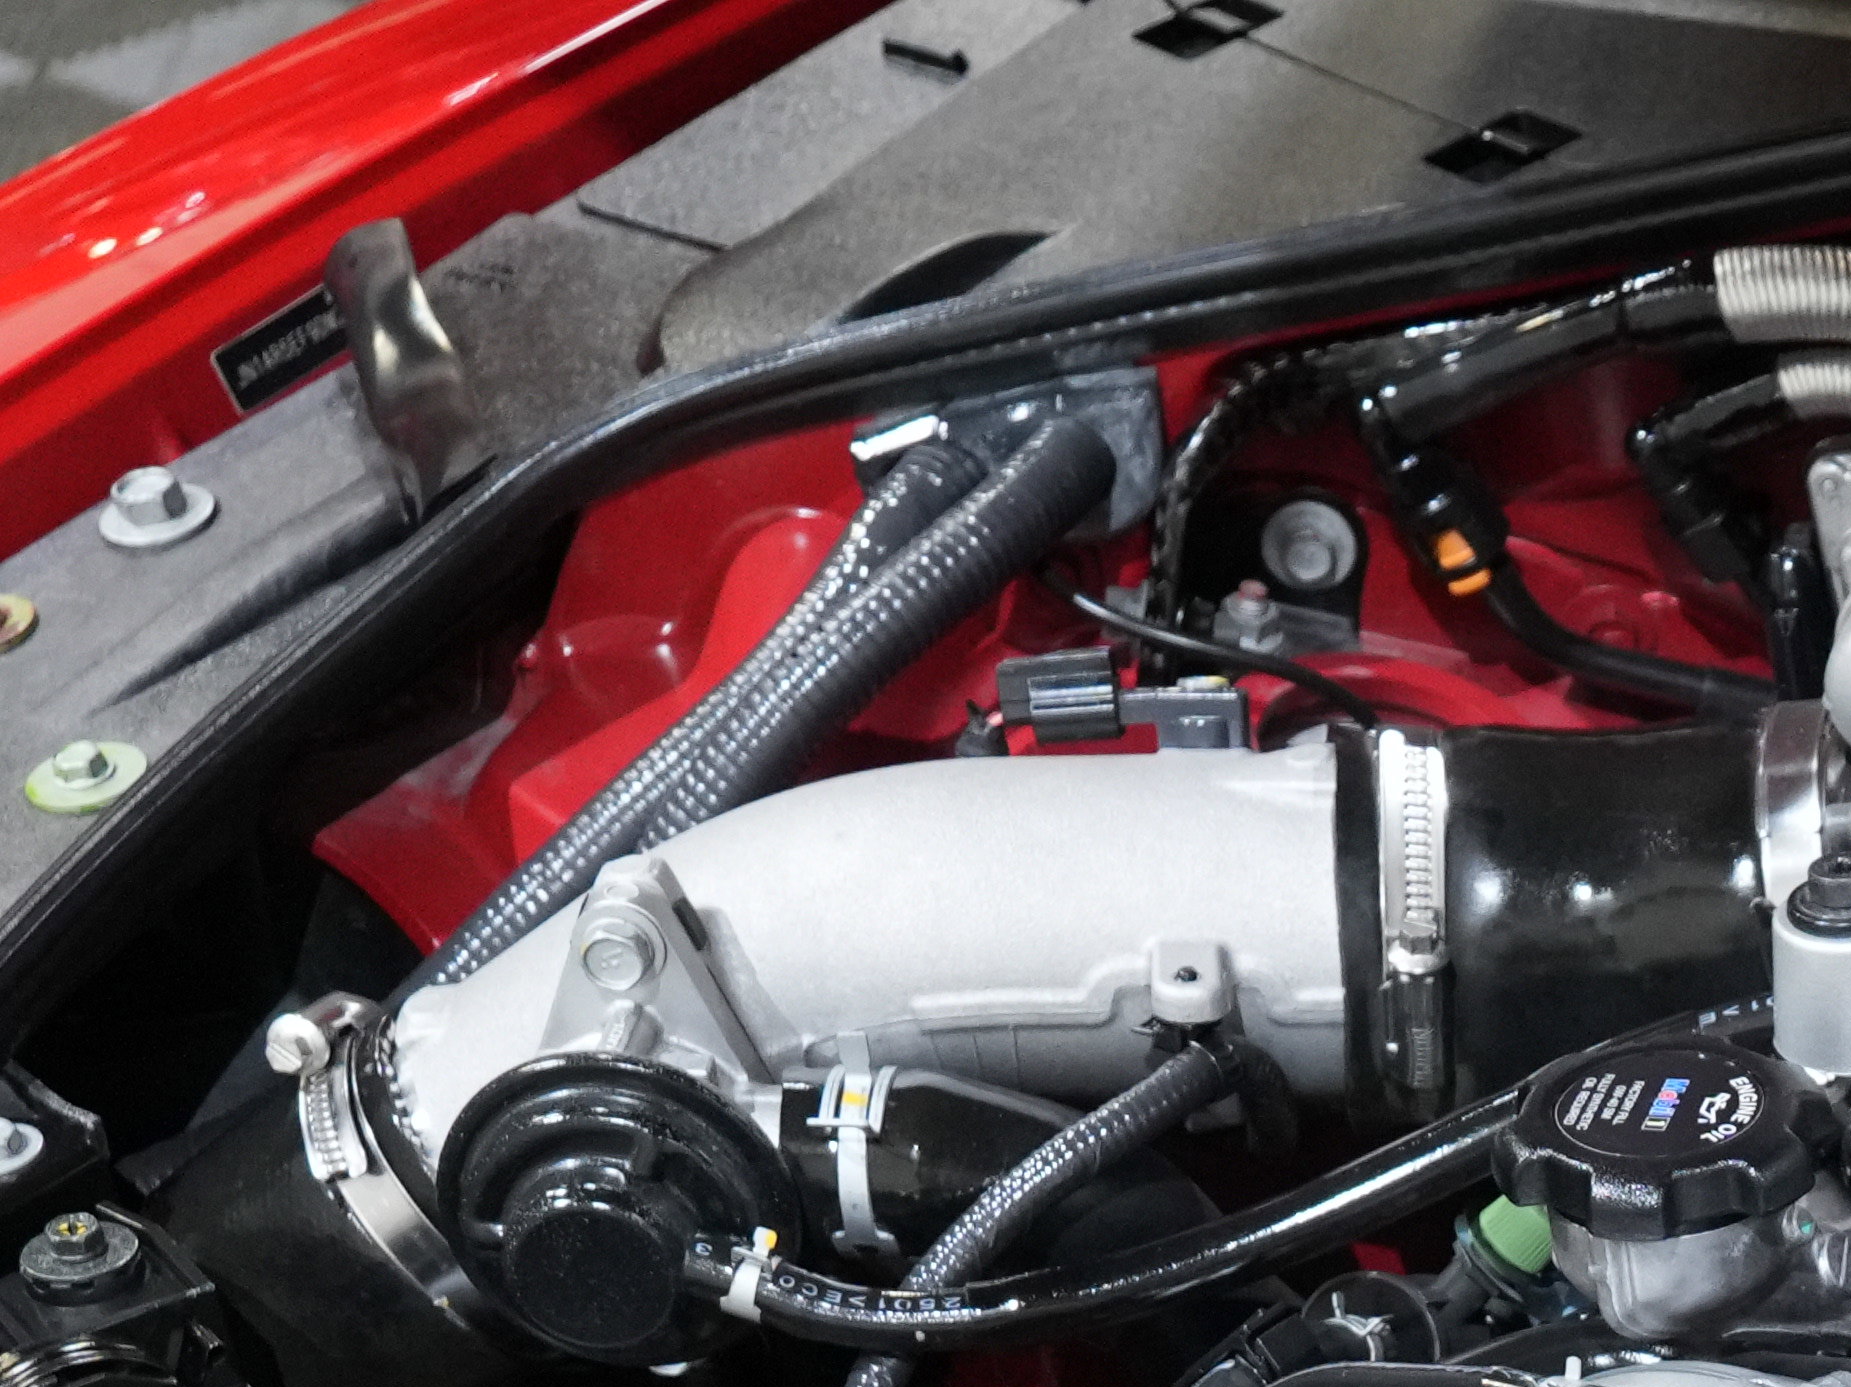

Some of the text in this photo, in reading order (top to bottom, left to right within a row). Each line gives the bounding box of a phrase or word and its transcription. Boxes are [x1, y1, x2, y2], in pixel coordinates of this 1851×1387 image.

[1648, 1078, 1690, 1117] Mobil
[1700, 1076, 1757, 1143] ENGINE OIL
